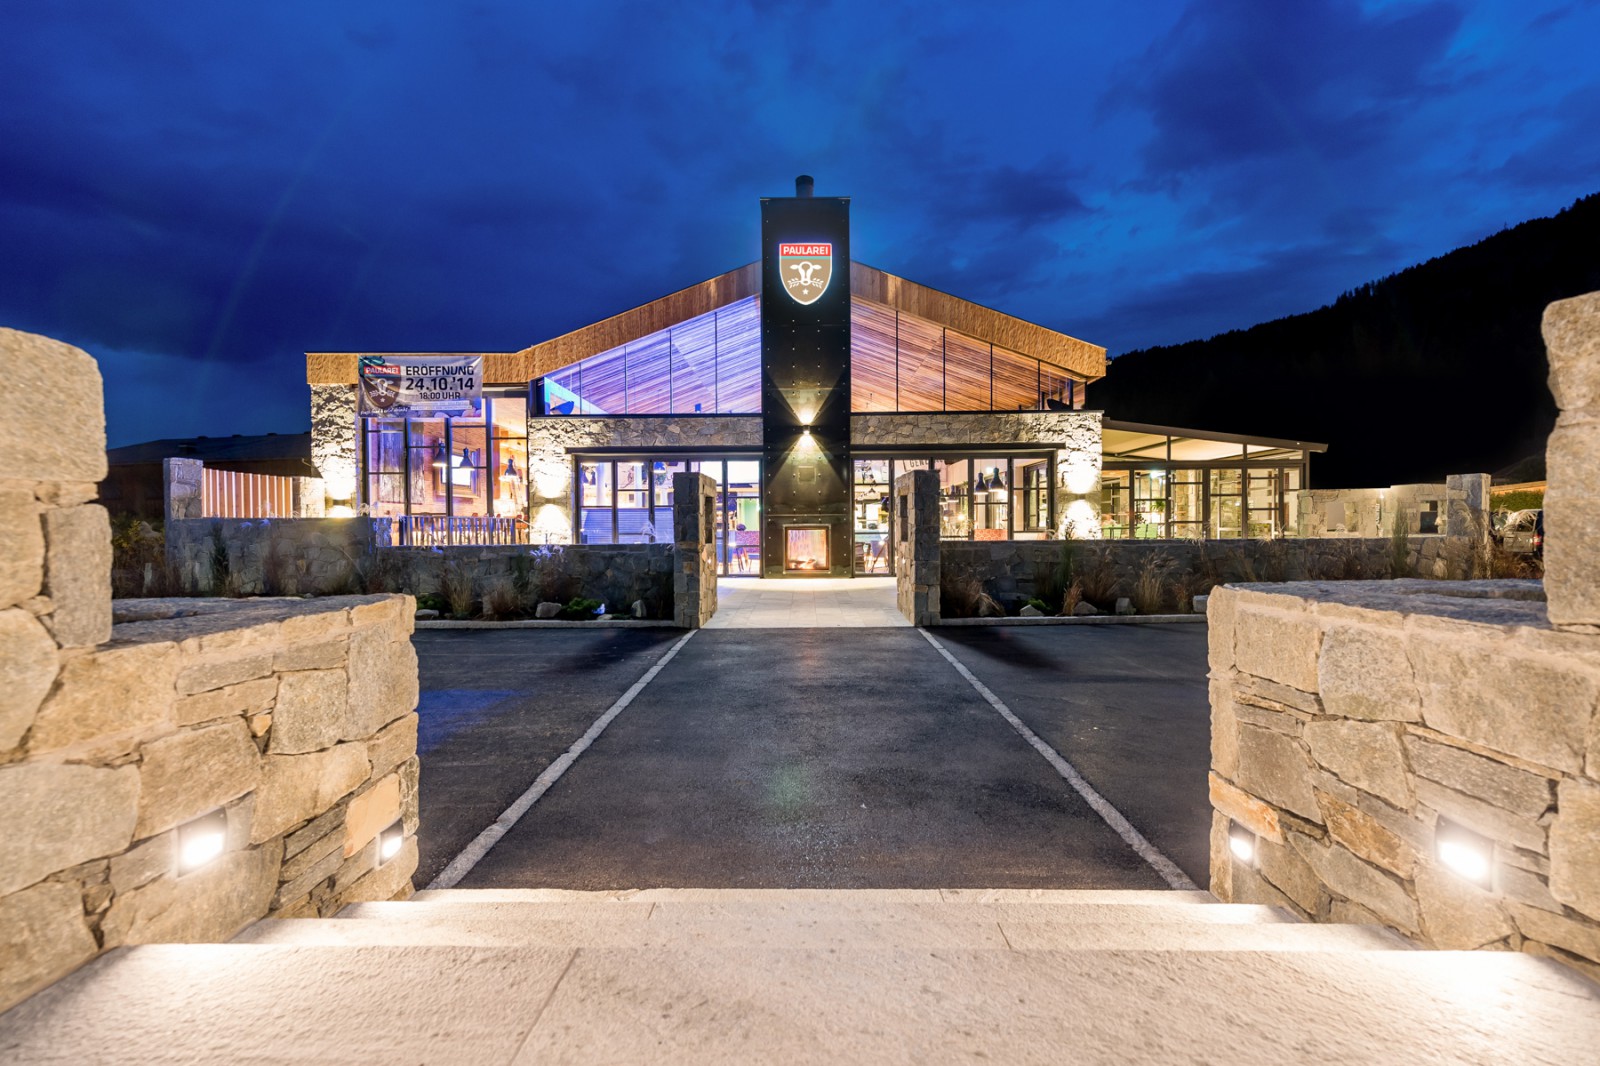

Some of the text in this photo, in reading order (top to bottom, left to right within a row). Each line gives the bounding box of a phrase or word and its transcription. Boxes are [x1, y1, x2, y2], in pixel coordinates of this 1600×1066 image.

[784, 246, 828, 255] PAULAREI
[405, 363, 474, 376] ERÖFFNUNG
[442, 391, 461, 400] UHR
